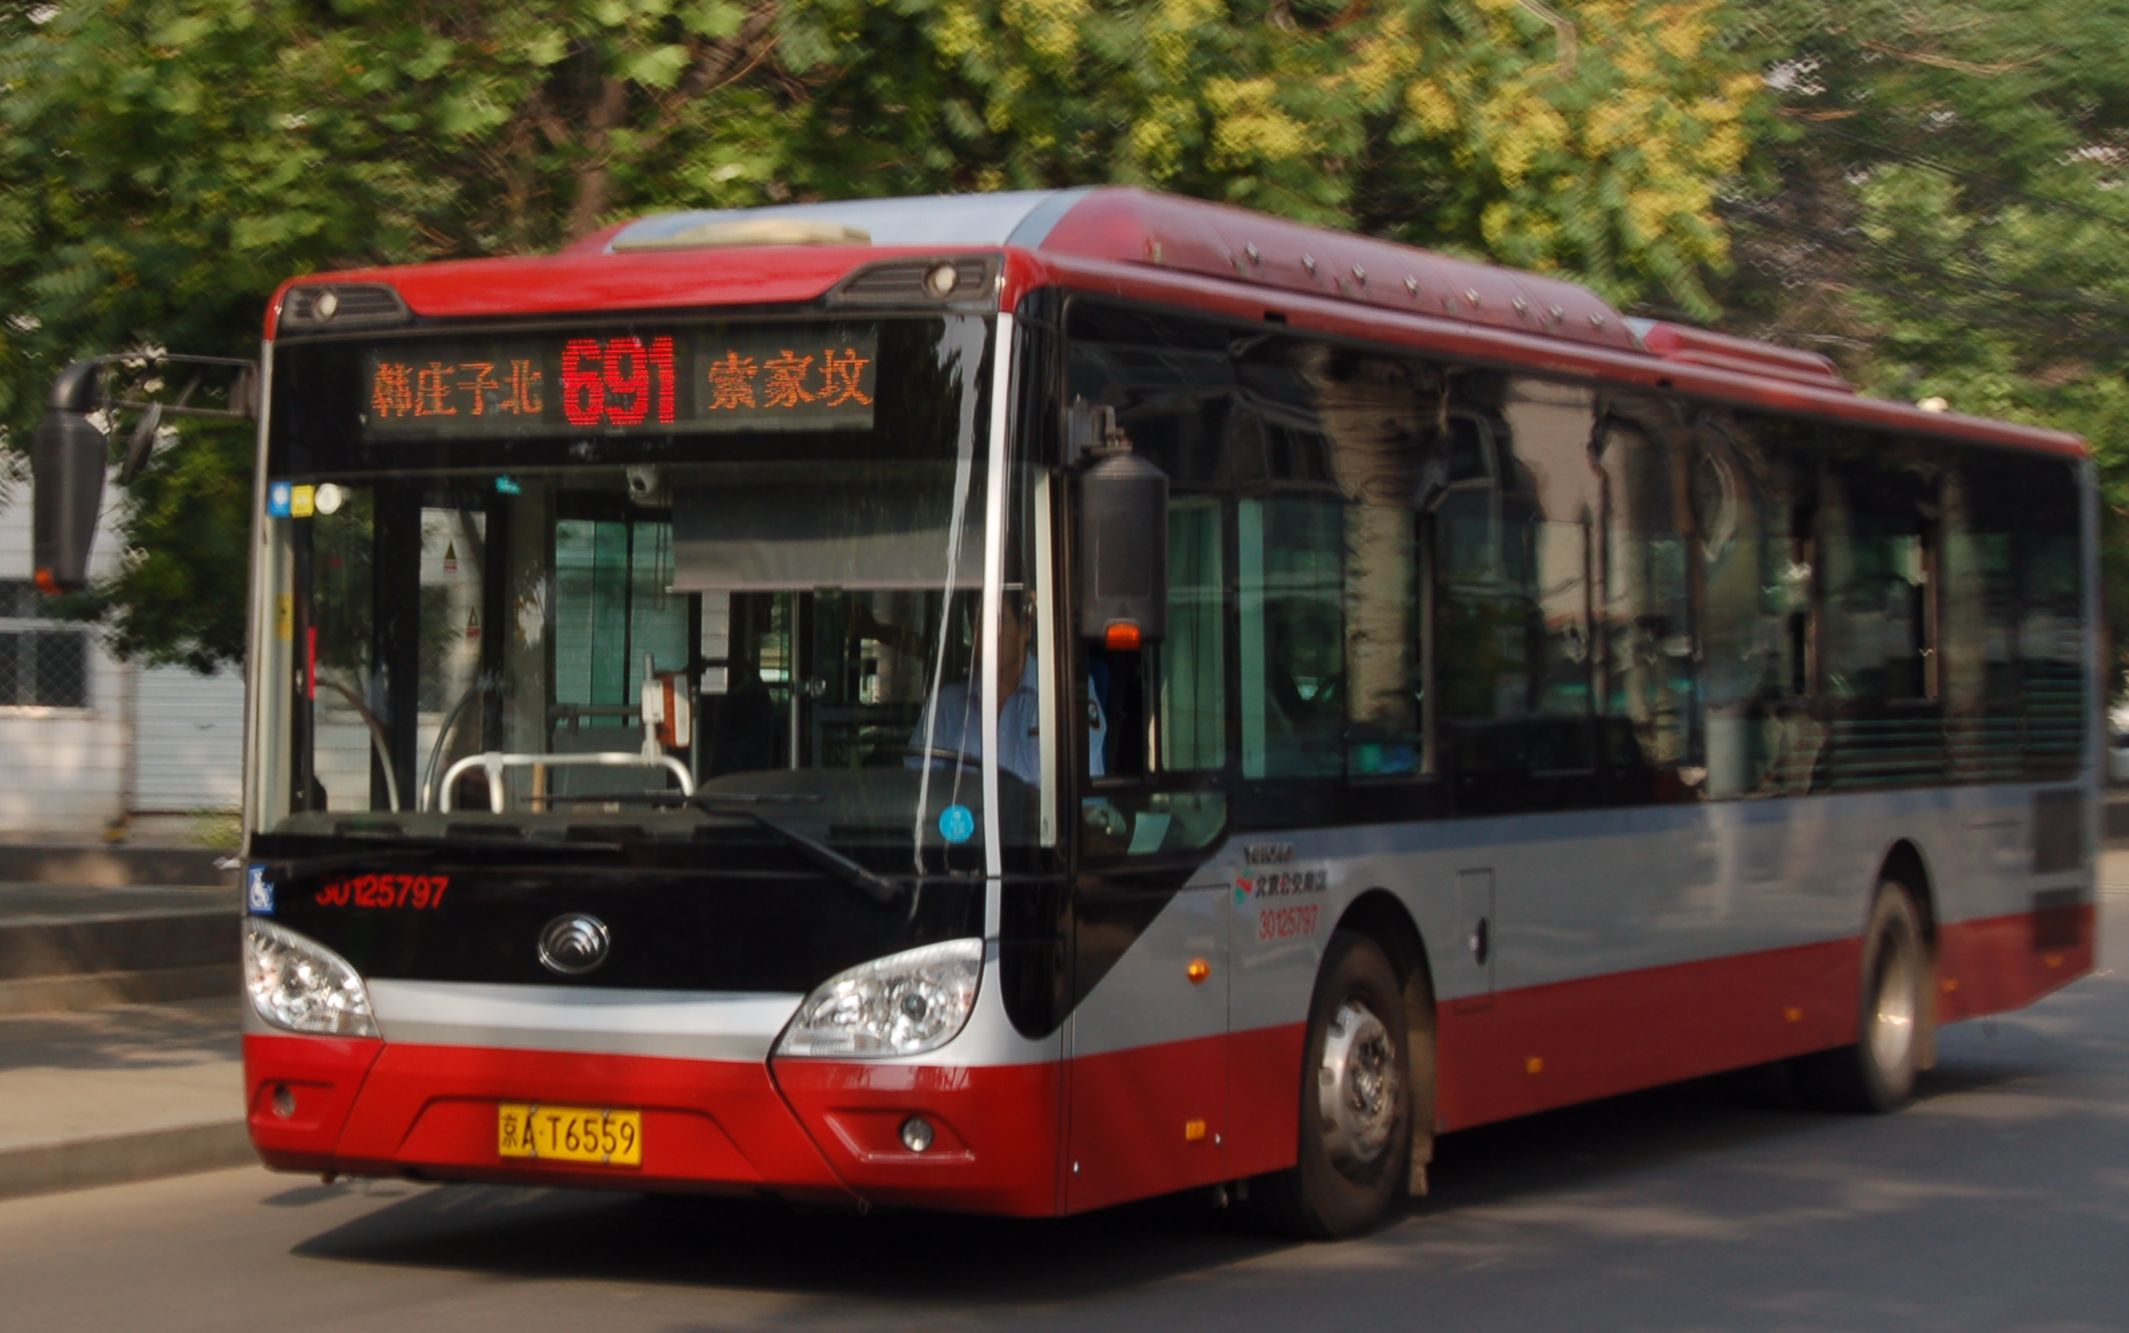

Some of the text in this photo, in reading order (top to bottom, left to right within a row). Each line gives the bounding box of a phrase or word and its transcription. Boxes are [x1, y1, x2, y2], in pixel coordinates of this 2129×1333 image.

[562, 336, 675, 426] 691
[707, 348, 875, 412] 索家坟
